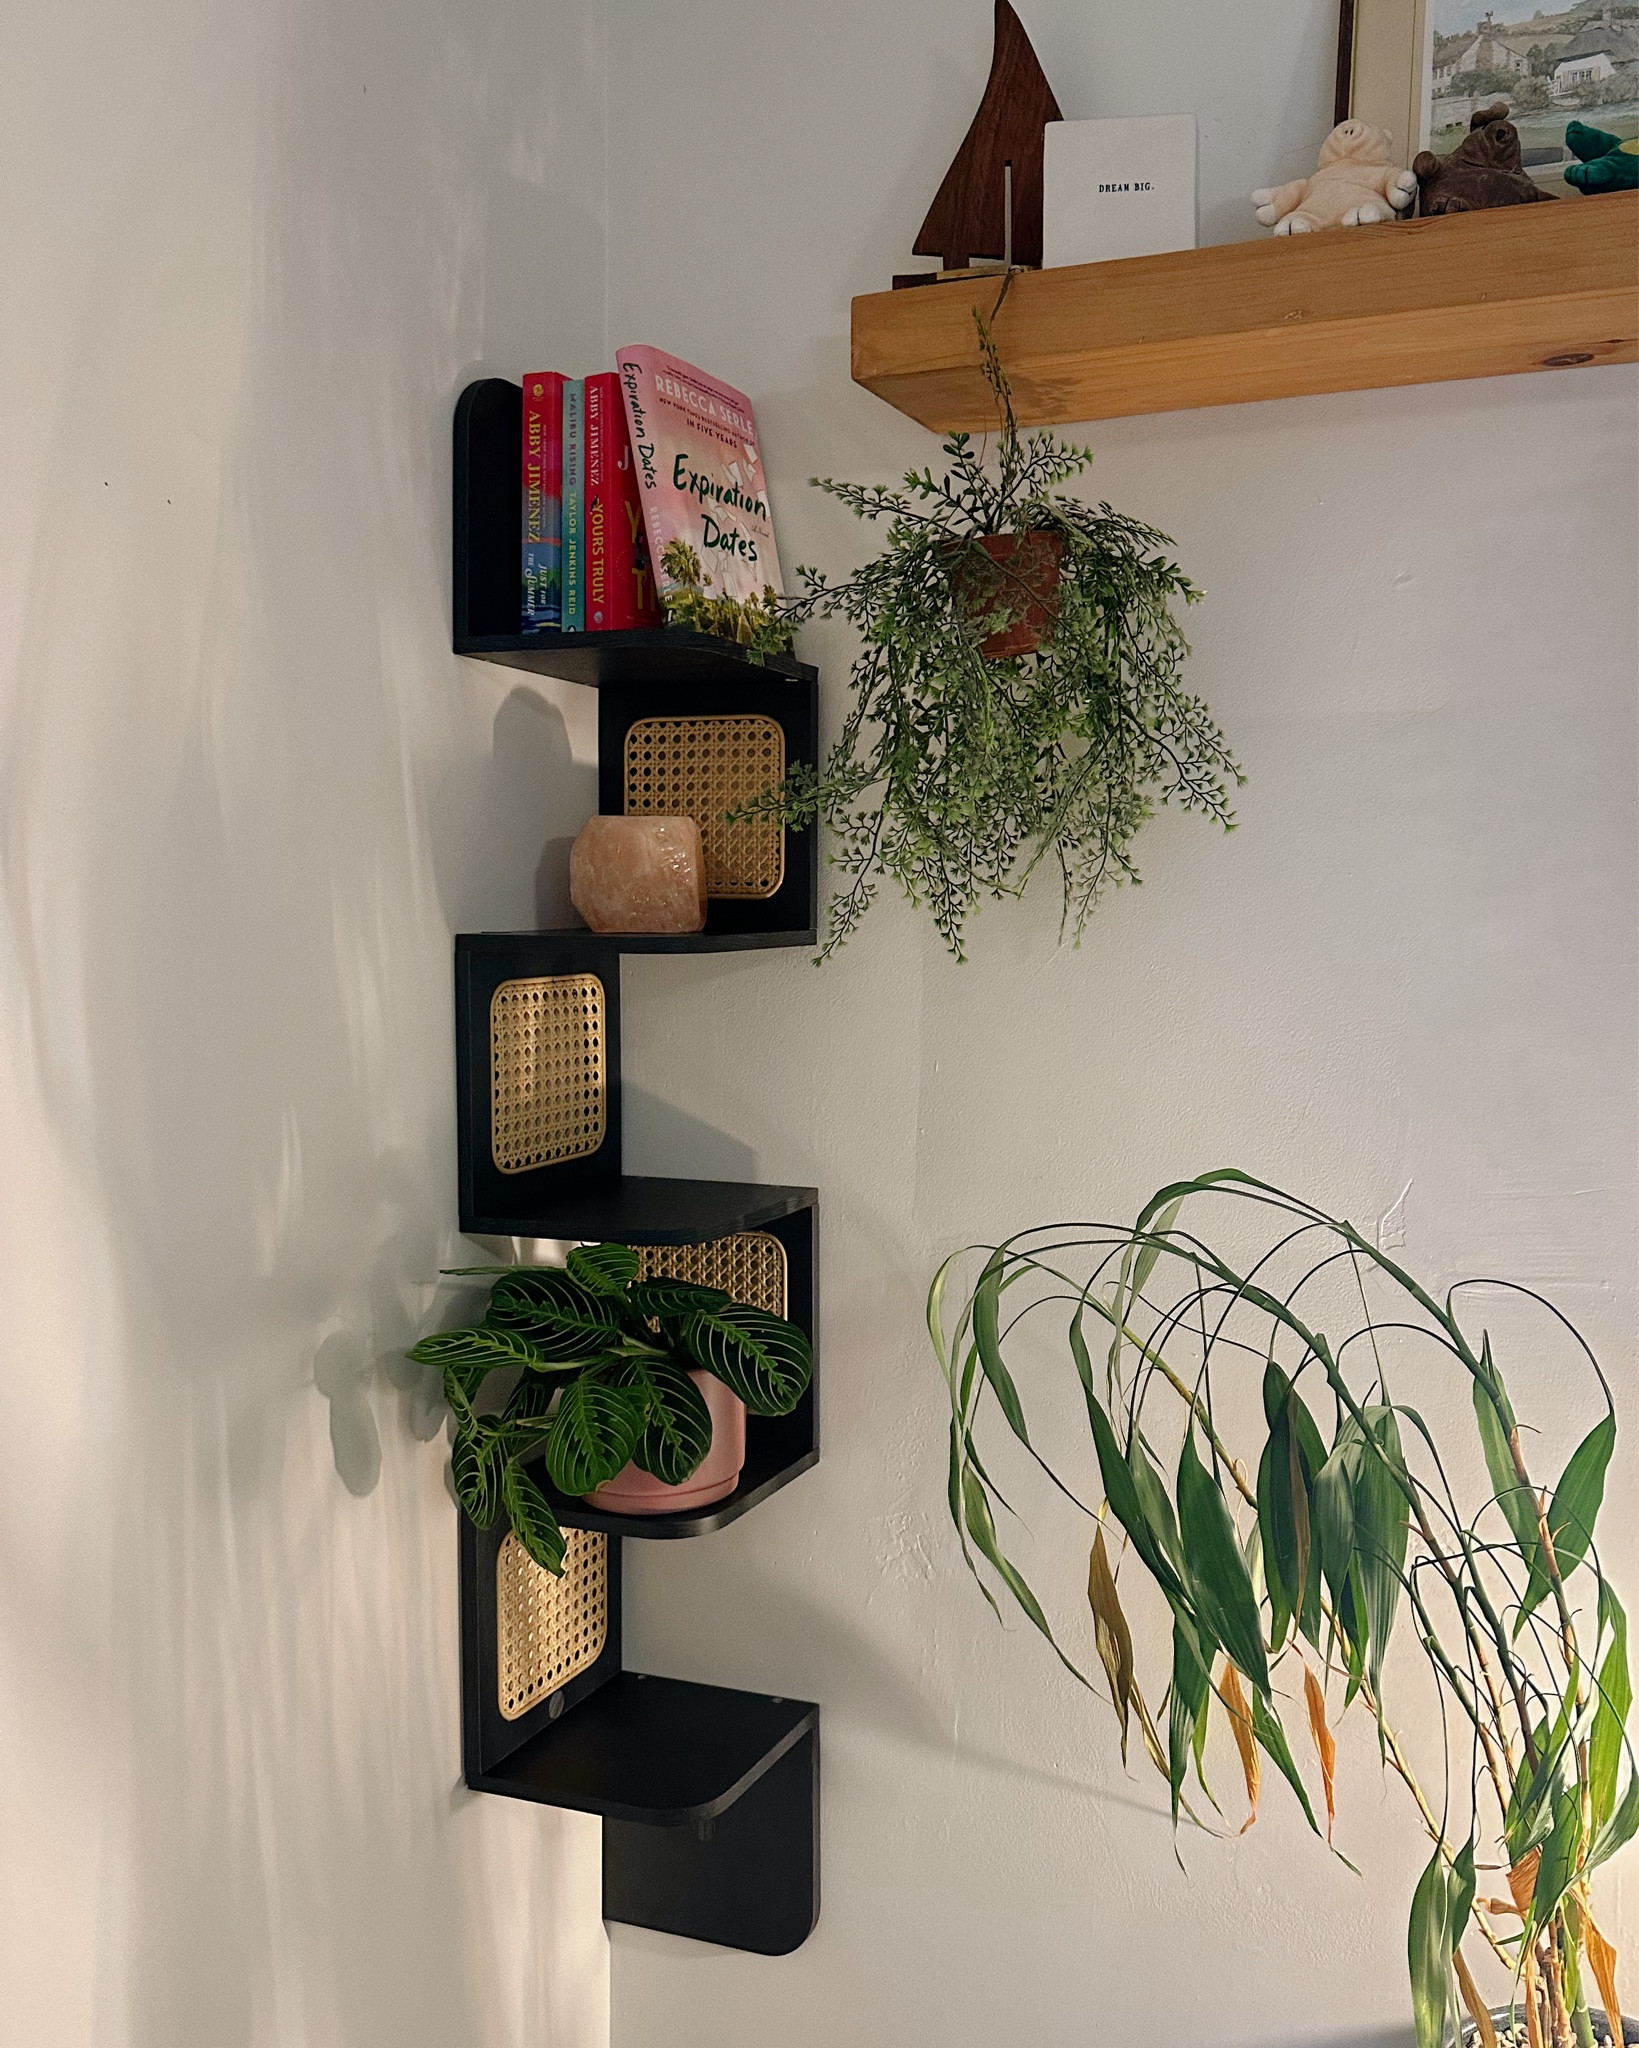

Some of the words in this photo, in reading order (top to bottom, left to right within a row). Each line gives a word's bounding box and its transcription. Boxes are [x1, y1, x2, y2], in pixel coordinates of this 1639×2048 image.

[1098, 184, 1130, 193] DREAM
[1134, 182, 1154, 192] BIG.
[590, 386, 599, 420] ABBY
[622, 362, 646, 438] Expiration
[638, 444, 656, 490] Dates
[655, 375, 716, 416] REBECCA
[720, 405, 754, 436] SERLE
[528, 410, 542, 458] ABBY
[590, 424, 600, 486] JIMENEZ
[686, 418, 694, 428] IN
[697, 422, 713, 436] FIVE
[715, 431, 737, 448] YEARS
[528, 463, 542, 543] JIMENEZ
[673, 454, 766, 522] Expiration
[568, 492, 576, 534] TAYLOR
[592, 504, 604, 556] YOURS
[650, 506, 665, 562] REBECCA
[702, 514, 758, 562] Dates
[538, 564, 548, 588] JUST
[568, 539, 576, 586] JENKINS
[592, 558, 604, 604] TRULY
[524, 568, 538, 616] SUMMER
[568, 590, 576, 615] REID
